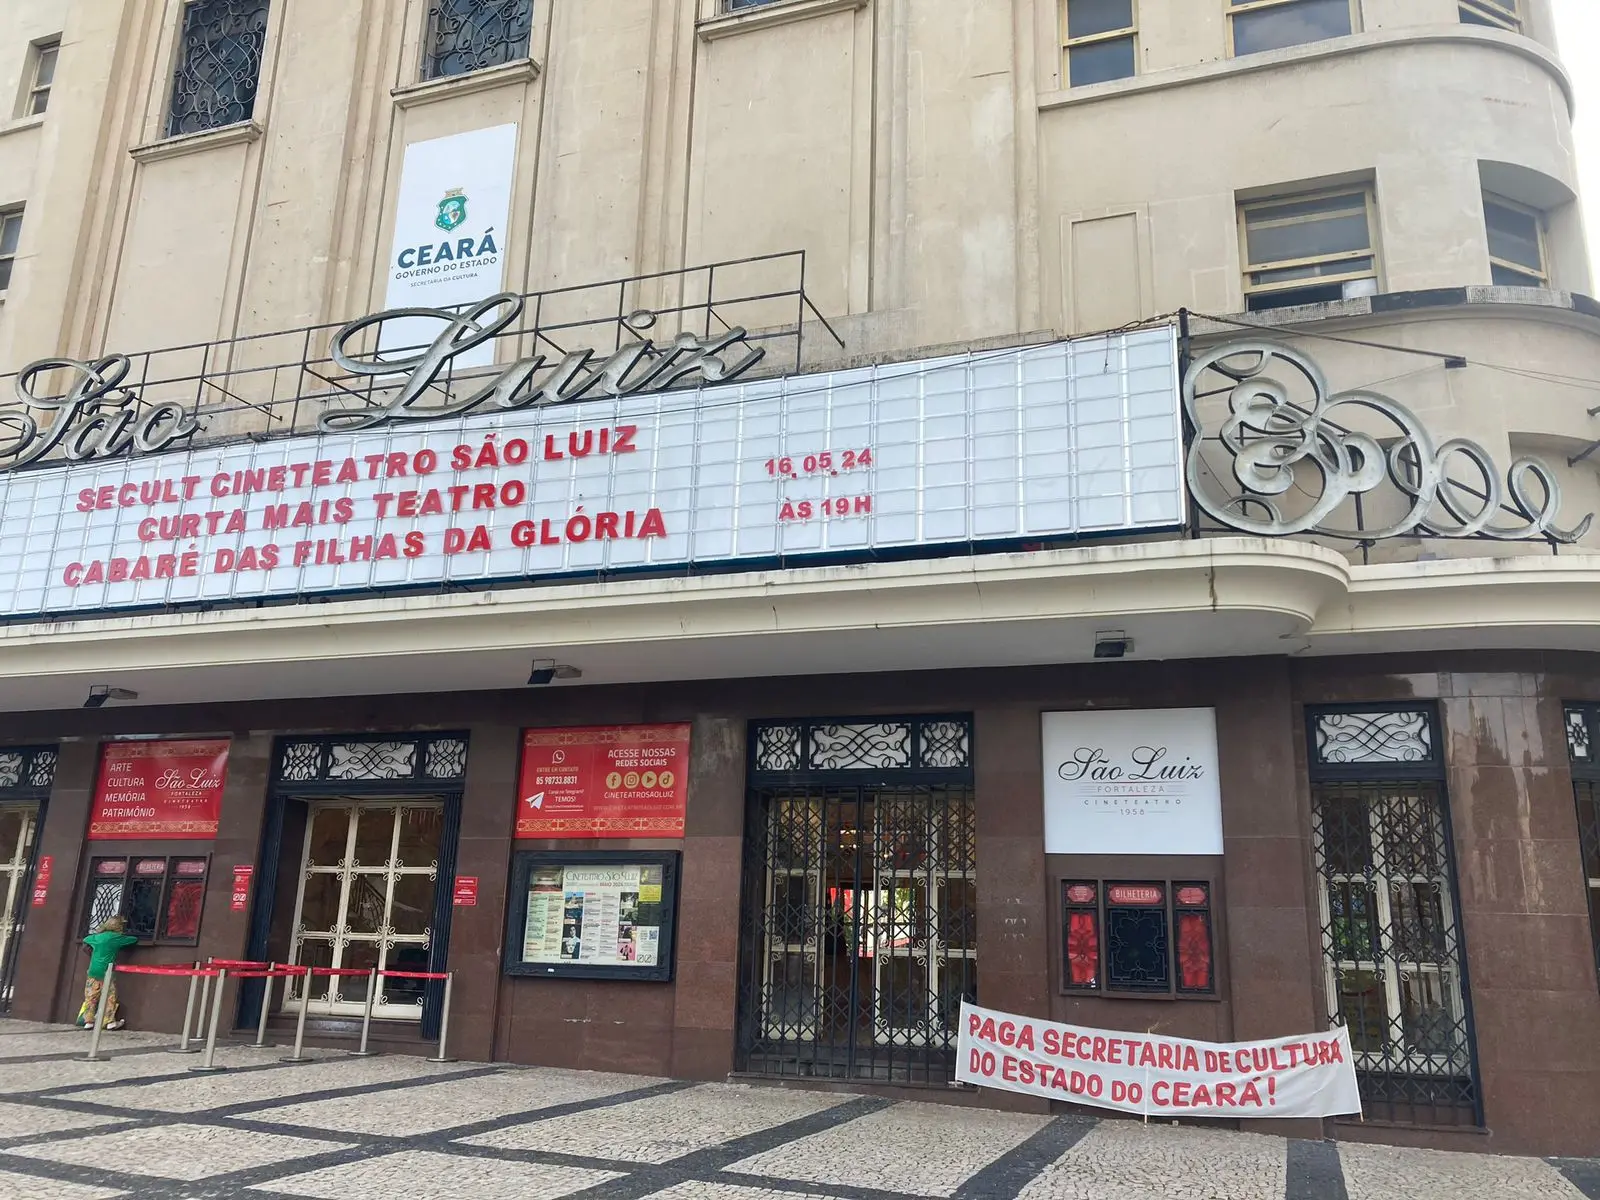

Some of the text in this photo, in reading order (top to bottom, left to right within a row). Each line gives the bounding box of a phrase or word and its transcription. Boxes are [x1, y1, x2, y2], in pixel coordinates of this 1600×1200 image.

[397, 226, 498, 269] CEARÁ
[395, 256, 497, 280] GOVERNO DO ESTADO
[410, 278, 443, 288] SECRETARIA
[451, 272, 478, 281] CULTURA
[0, 290, 766, 468] São Luiz
[77, 425, 638, 512] SECULT CINETEATRO SÃO LUIZ
[138, 478, 527, 542] CURTA MAIS TEATRO
[779, 497, 814, 520] ÀS
[63, 504, 668, 587] CABARÉ DAS FILHAS DA GLÓRIA
[607, 747, 676, 758] ACESSE NOSSAS
[615, 758, 667, 767] REDES SOCIAIS
[1058, 746, 1204, 781] São Luiz
[110, 762, 133, 772] ARTE
[155, 767, 222, 790] São Luiz
[107, 777, 145, 787] CULTURA
[1097, 785, 1165, 793] FORTALEZA
[104, 790, 146, 802] MEMÓRIA
[101, 805, 156, 818] PATRIMÔNIO
[1120, 808, 1145, 816] 1958
[1115, 889, 1158, 899] BILHETERIA
[969, 1013, 1344, 1074] PAGA SECRETARIA DE CULTURA
[969, 1047, 1277, 1108] DO ESTADO DO CEARÁ!
